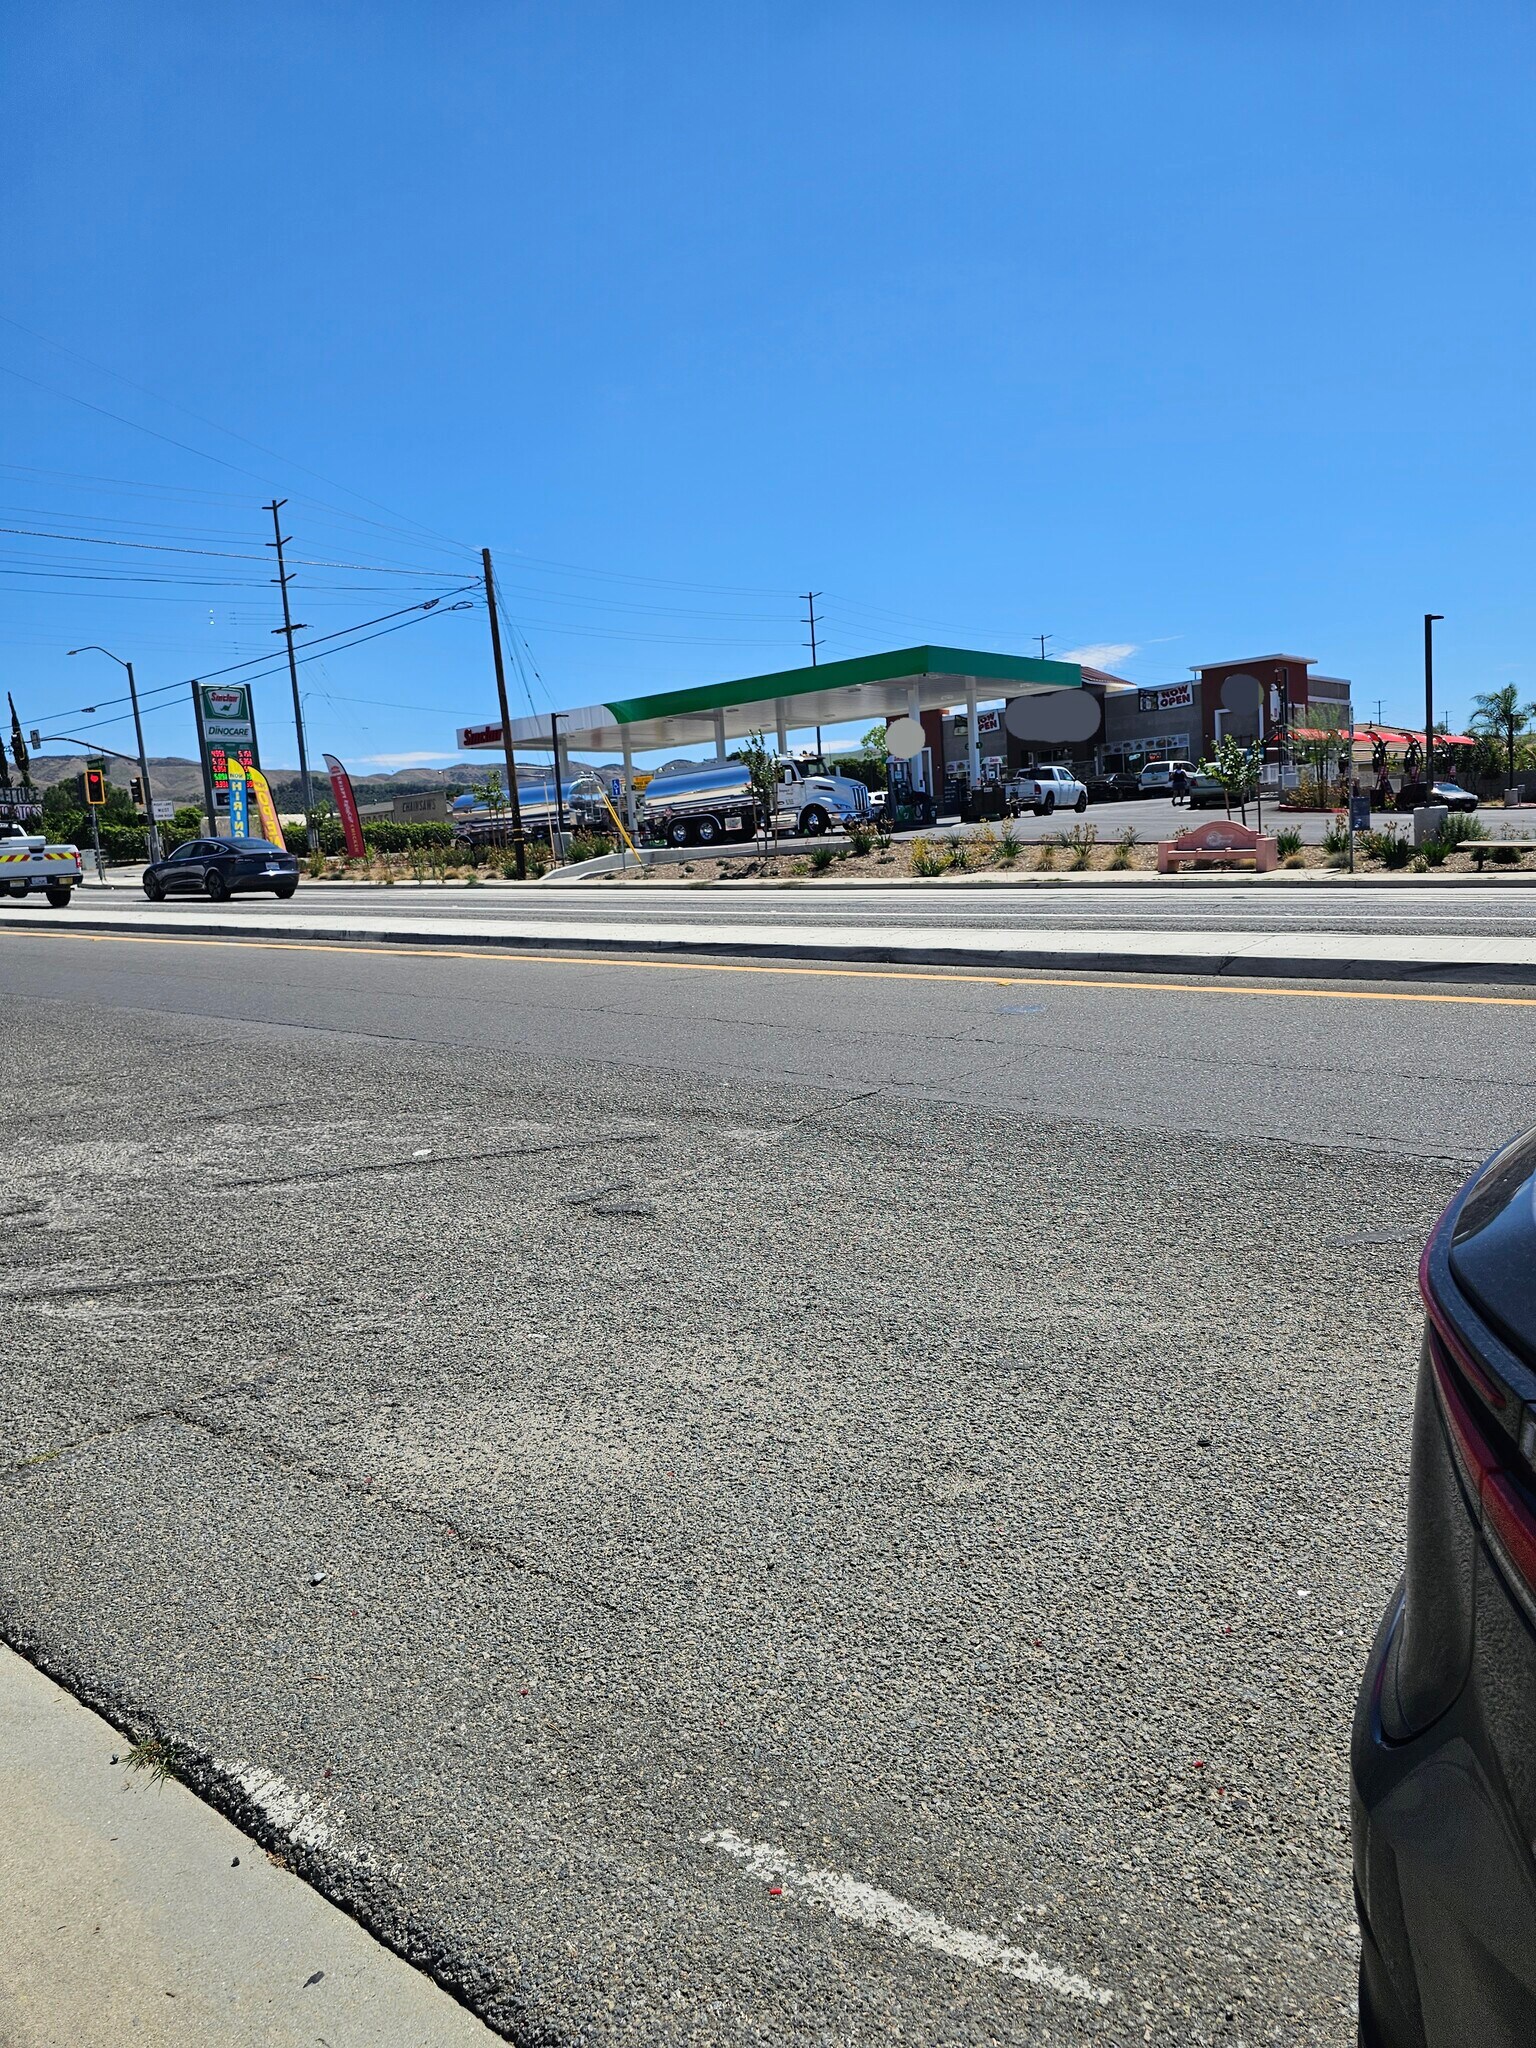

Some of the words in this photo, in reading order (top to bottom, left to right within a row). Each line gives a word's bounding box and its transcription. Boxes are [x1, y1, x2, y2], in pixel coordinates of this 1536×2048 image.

[211, 692, 239, 702] Sinclair
[1161, 685, 1188, 698] NOW
[1160, 694, 1191, 707] OPEN
[979, 720, 997, 731] PEN
[231, 781, 245, 838] HIRING
[403, 799, 436, 812] CHAINSAWS
